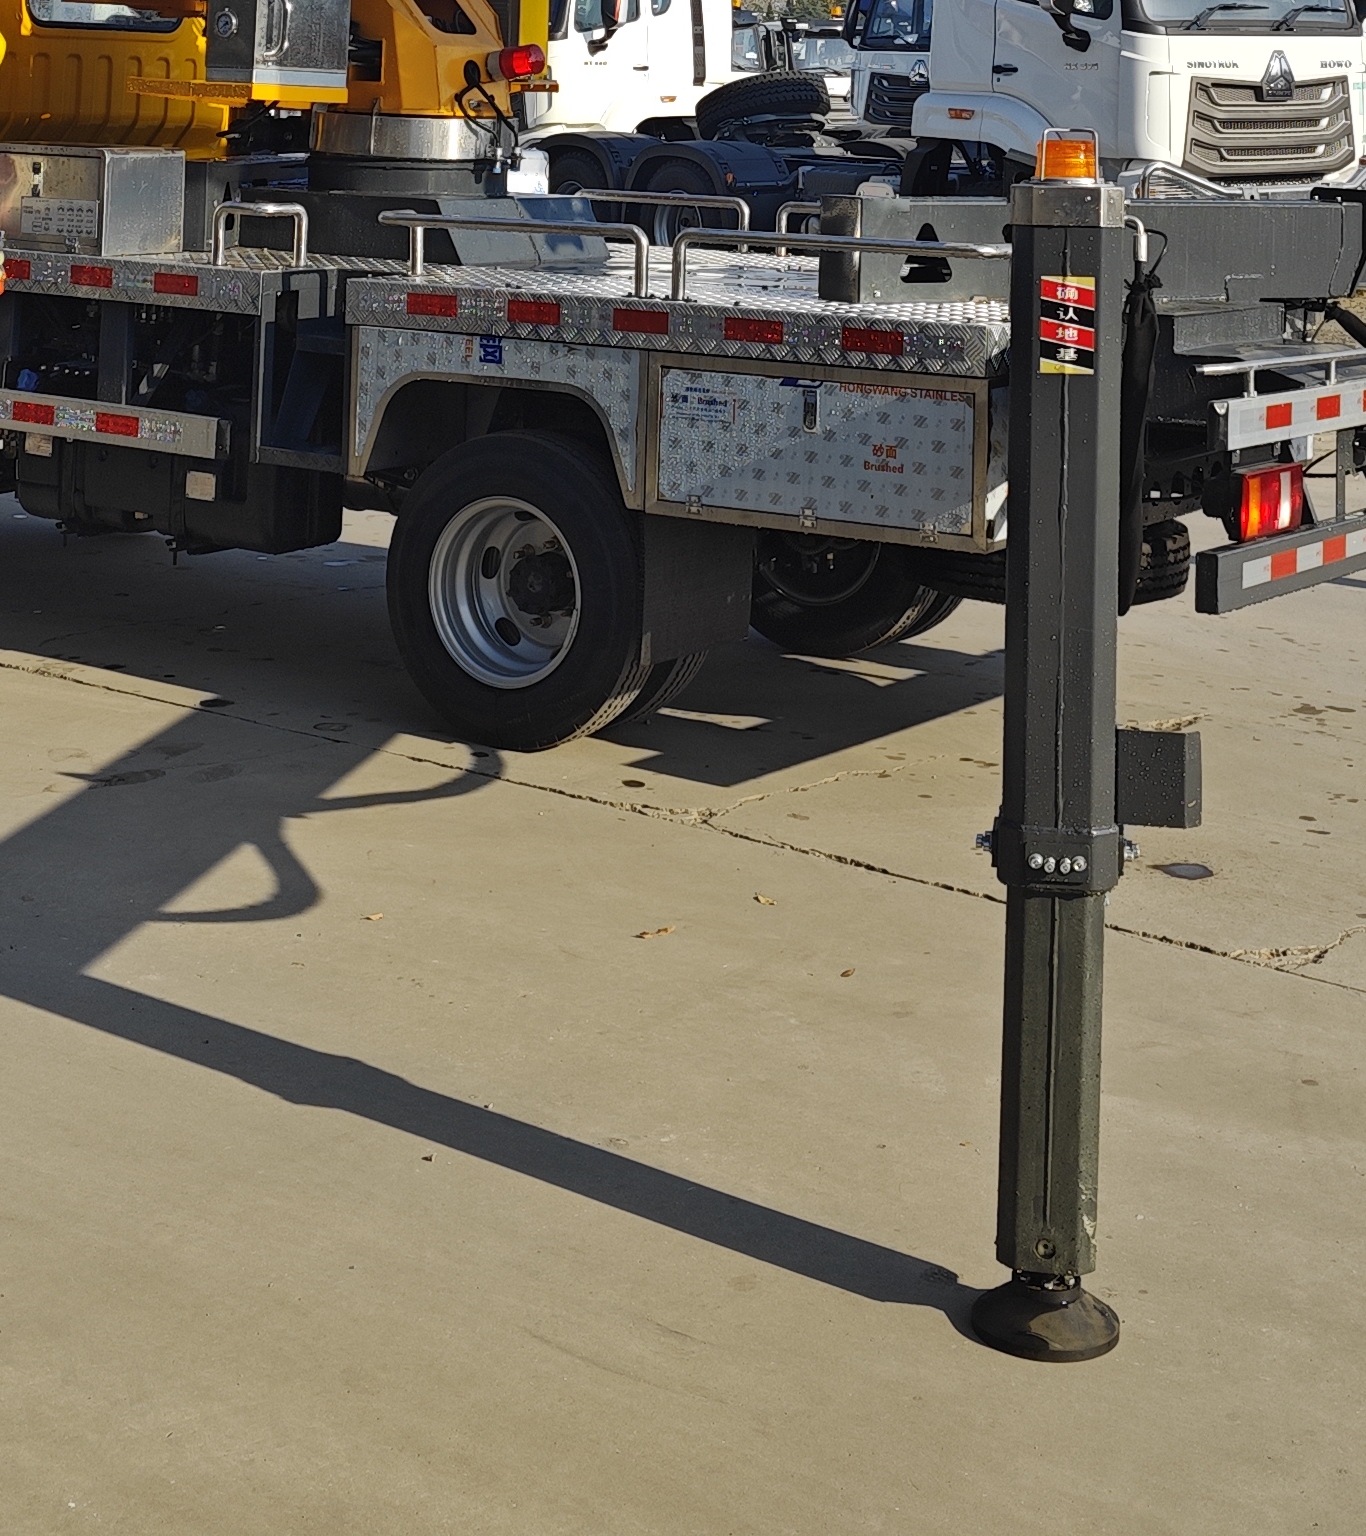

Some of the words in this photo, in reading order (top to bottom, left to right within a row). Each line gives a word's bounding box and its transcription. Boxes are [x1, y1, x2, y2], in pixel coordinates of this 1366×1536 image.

[1319, 60, 1353, 69] HOWO
[871, 443, 898, 460] 砂面
[863, 459, 905, 474] Brushed
